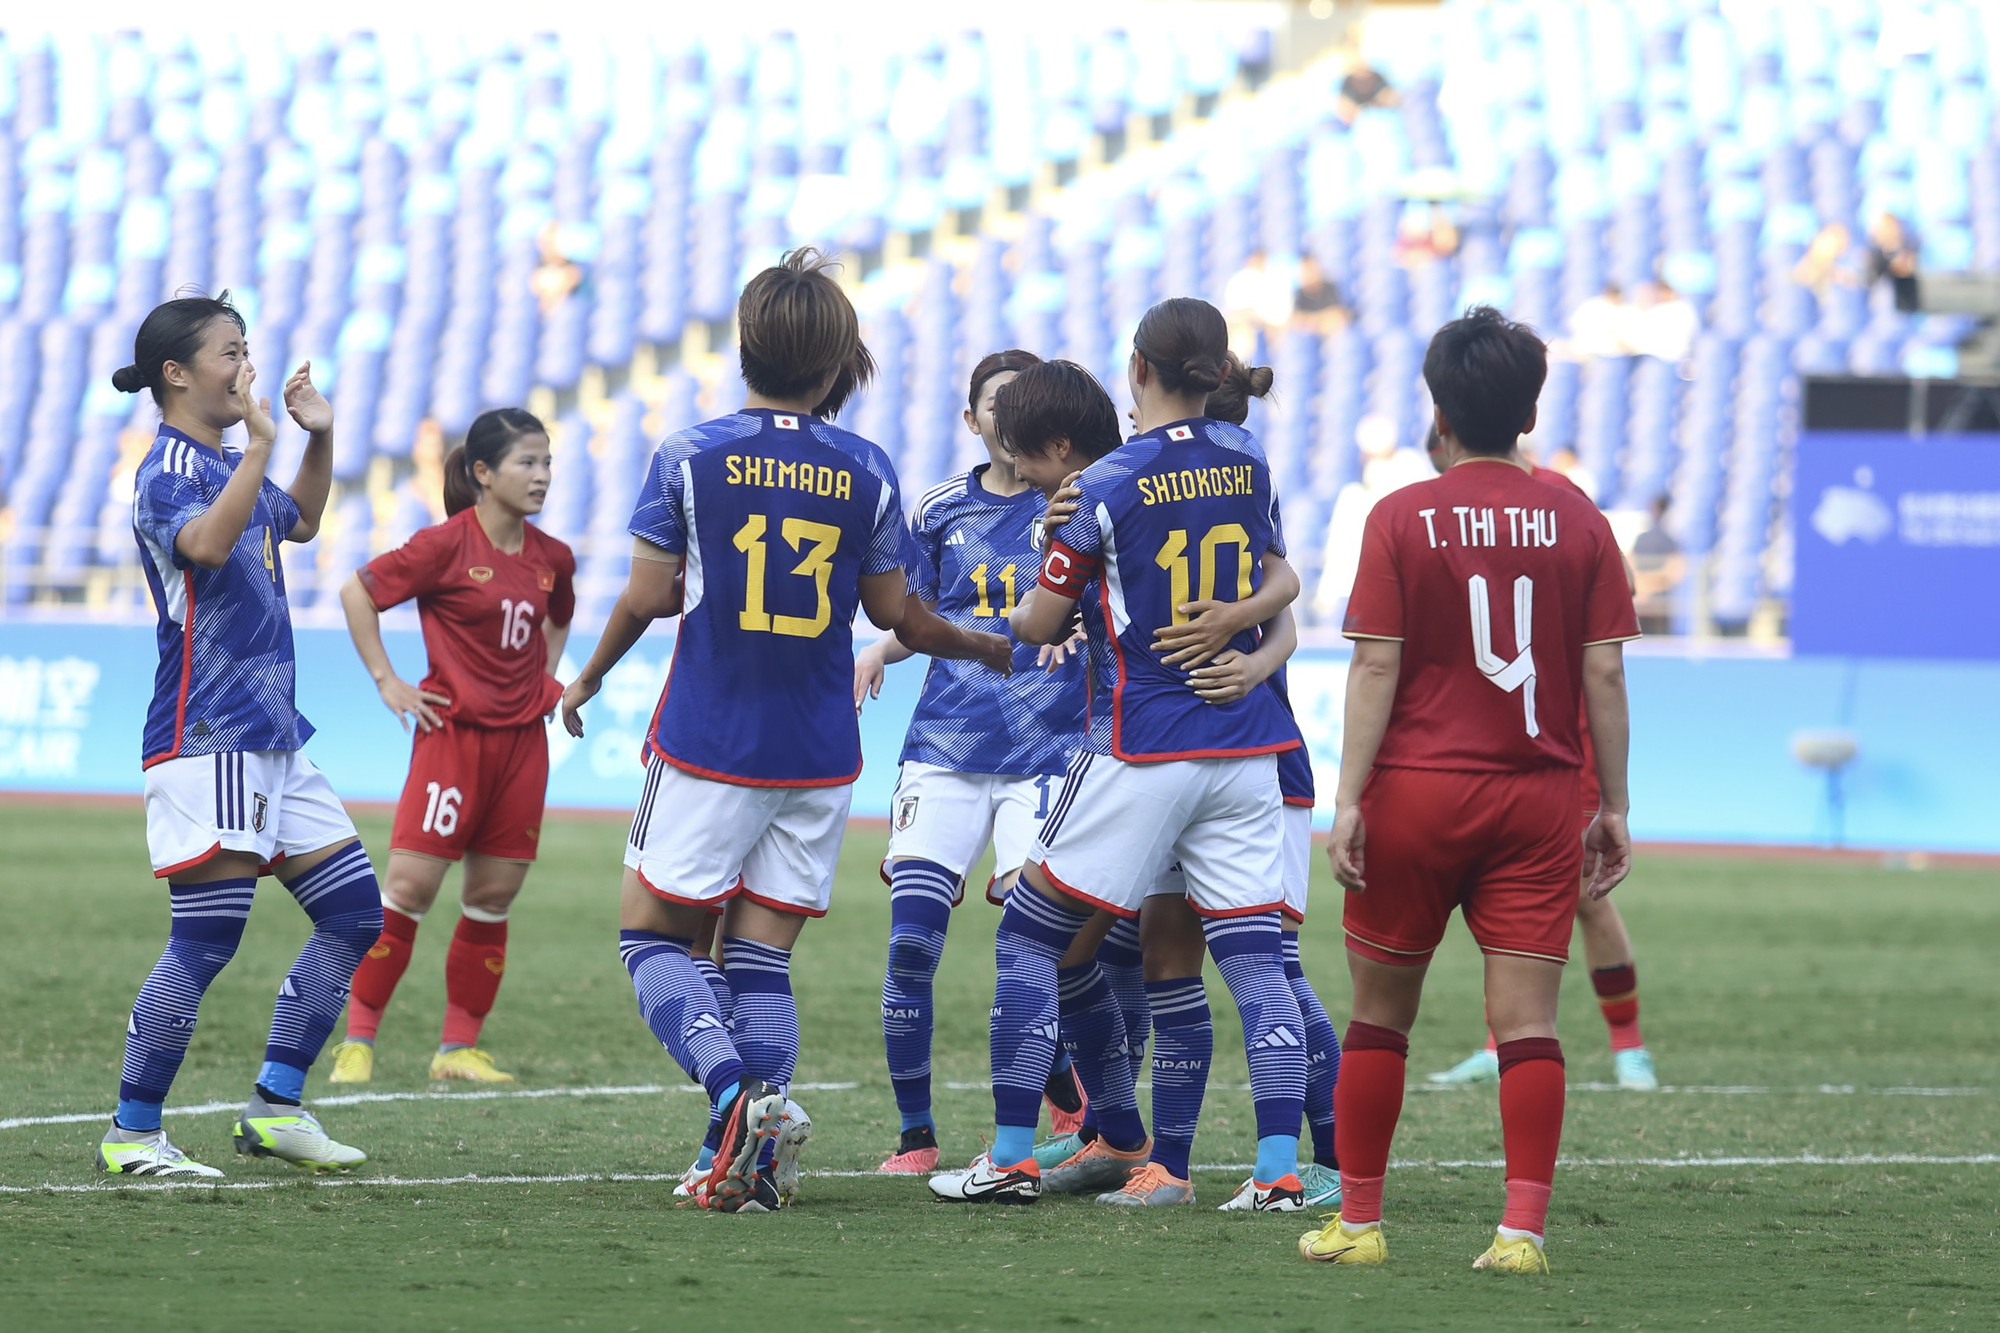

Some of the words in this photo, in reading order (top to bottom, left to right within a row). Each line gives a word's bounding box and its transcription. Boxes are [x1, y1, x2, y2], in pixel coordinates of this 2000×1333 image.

[725, 455, 852, 501] SHIMADA
[1137, 465, 1254, 506] SHIOKOSHI
[1418, 508, 1448, 549] T.
[1452, 507, 1496, 547] THI
[1503, 507, 1557, 548] THU
[732, 514, 842, 639] 13
[969, 563, 1017, 618] 11
[1045, 550, 1071, 585] C
[1154, 523, 1253, 642] 10
[501, 598, 535, 651] 16
[1468, 574, 1540, 739] 4
[422, 781, 463, 838] 16
[882, 1006, 919, 1019] PAN
